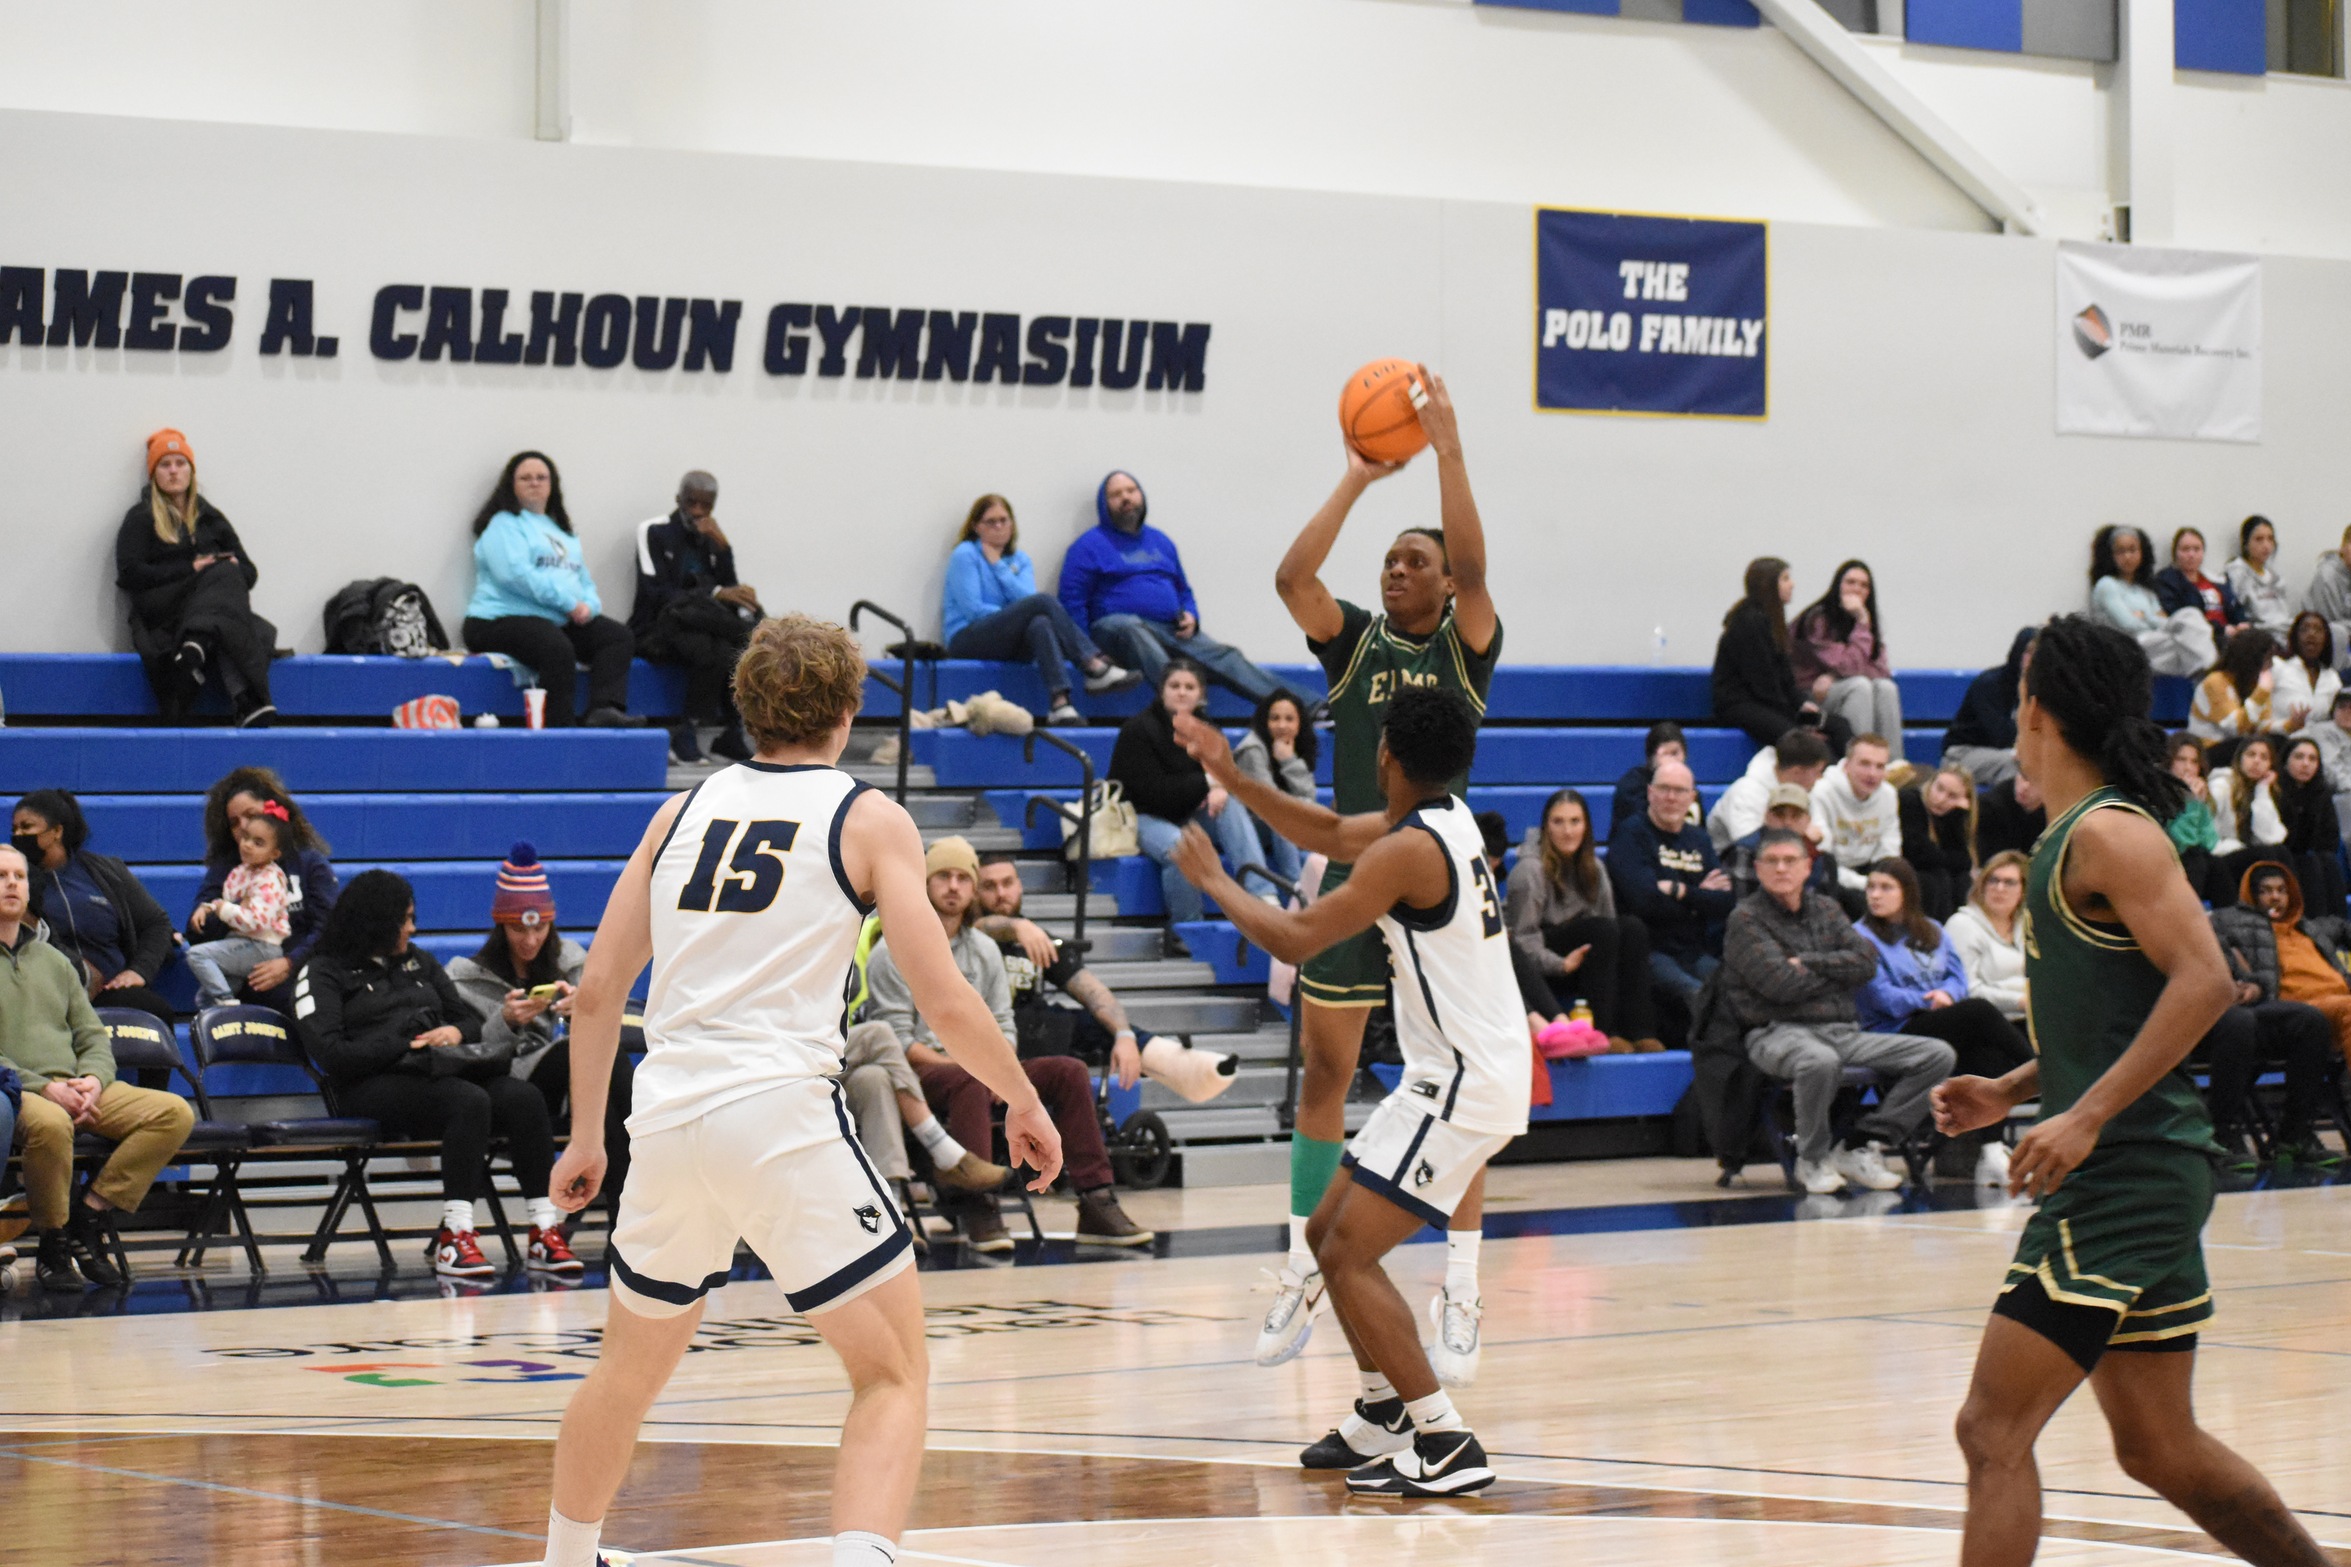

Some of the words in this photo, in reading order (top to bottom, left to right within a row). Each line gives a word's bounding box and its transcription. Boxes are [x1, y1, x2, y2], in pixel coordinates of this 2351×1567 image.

[1619, 260, 1690, 302] THE
[259, 278, 339, 358] A.
[369, 284, 742, 375] CALHOUN
[763, 303, 1211, 393] GYMNASIUM
[1542, 308, 1632, 352] POLO
[1638, 314, 1765, 358] FAMILY
[2119, 323, 2151, 338] PMR
[677, 818, 802, 914] 15
